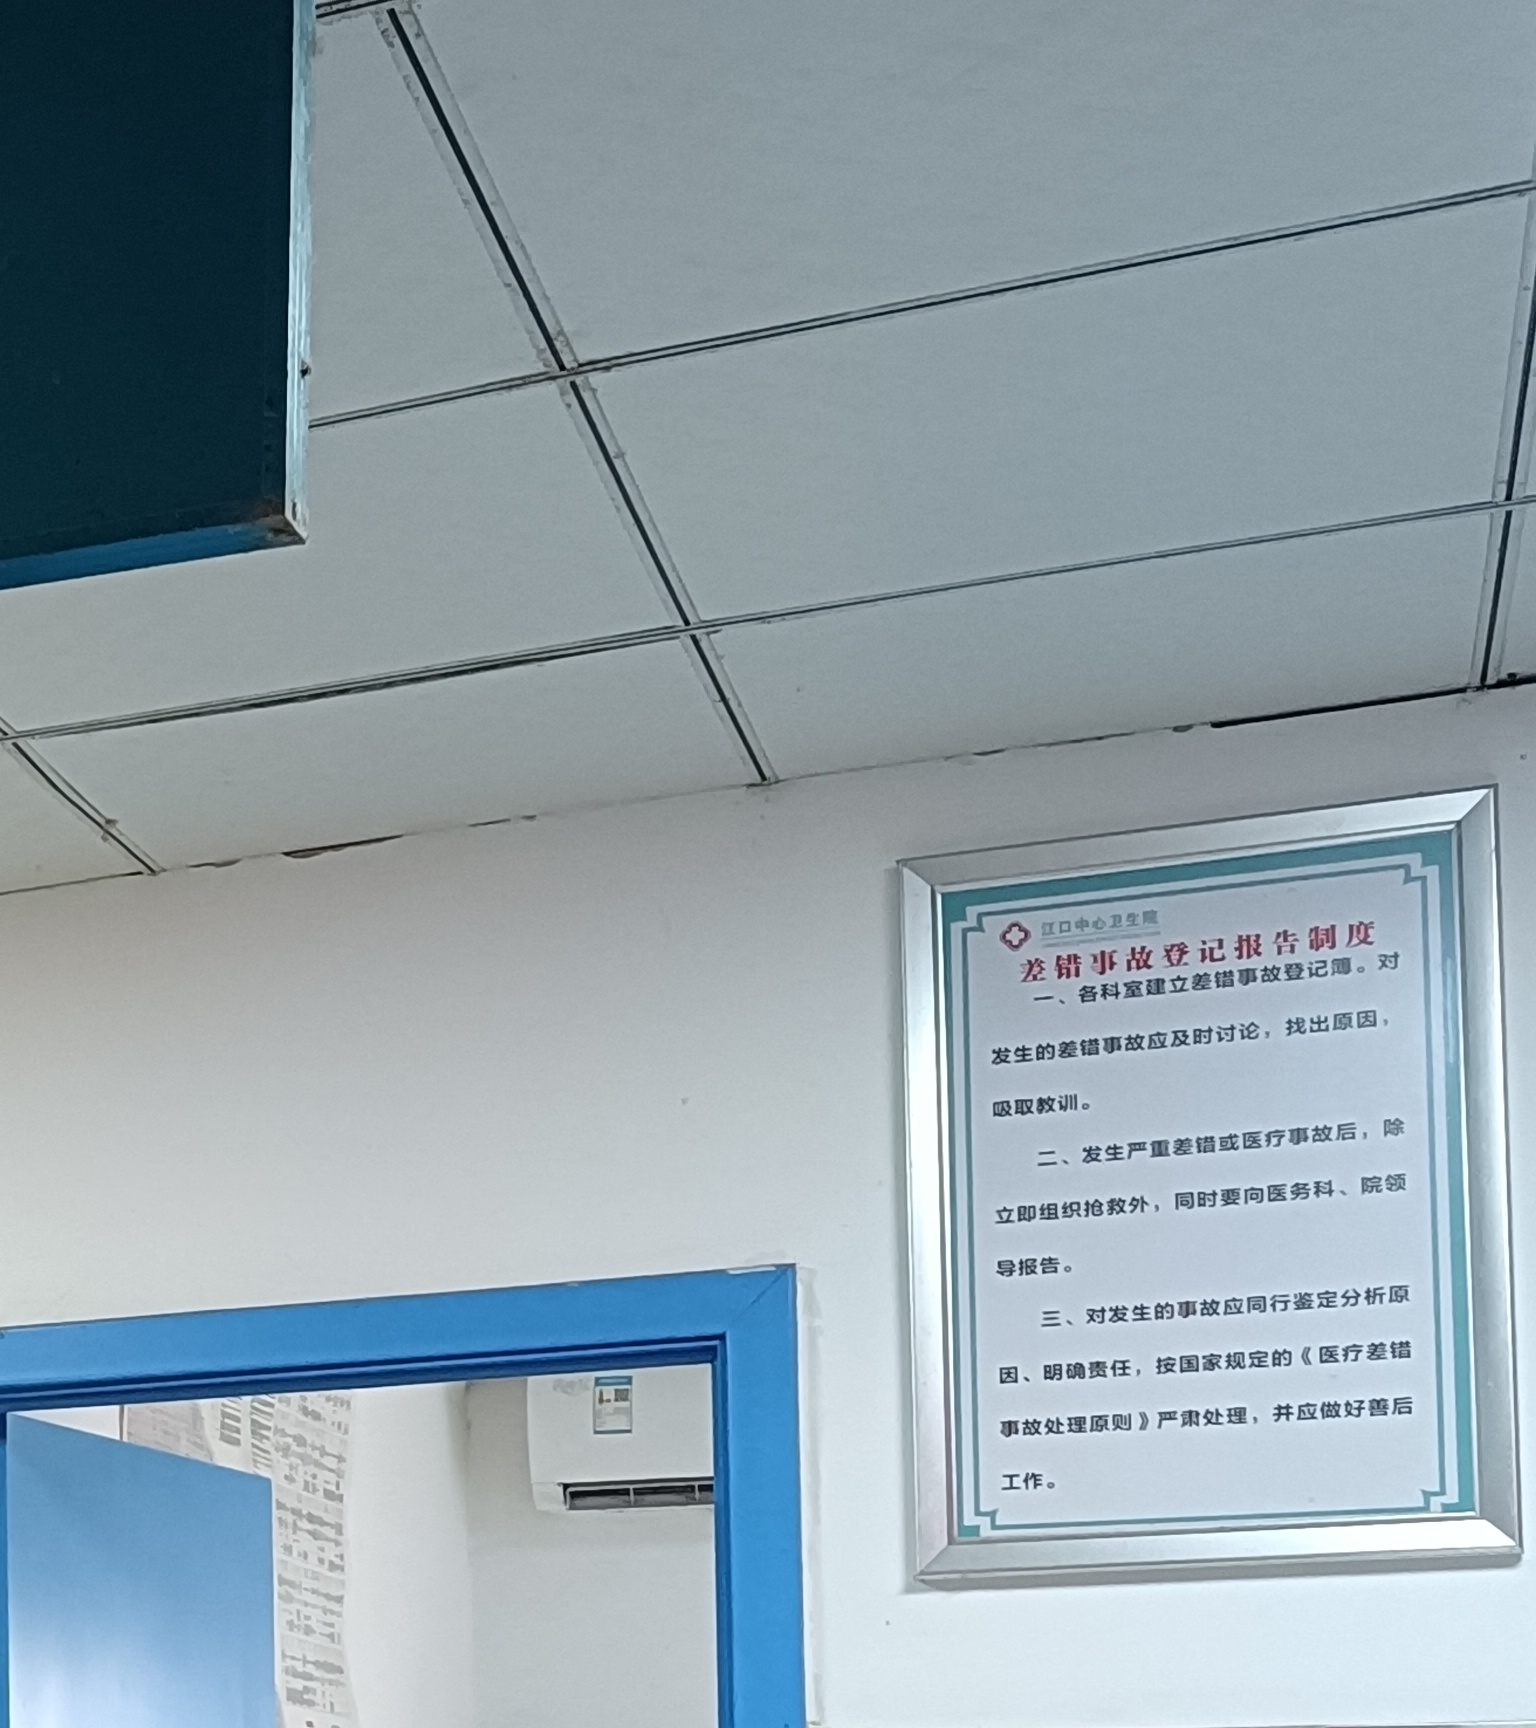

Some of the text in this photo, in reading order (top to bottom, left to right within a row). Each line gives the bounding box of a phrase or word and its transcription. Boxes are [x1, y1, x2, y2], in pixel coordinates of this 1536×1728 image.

[1019, 920, 1374, 982] 差错事故登记报告制度
[992, 1093, 1090, 1117] 吸取教训。
[1037, 1117, 1404, 1166] 二、发生严重差错或医疗事故后，除
[995, 1256, 1071, 1277] 导报告。
[1000, 1472, 1055, 1490] 工作。
